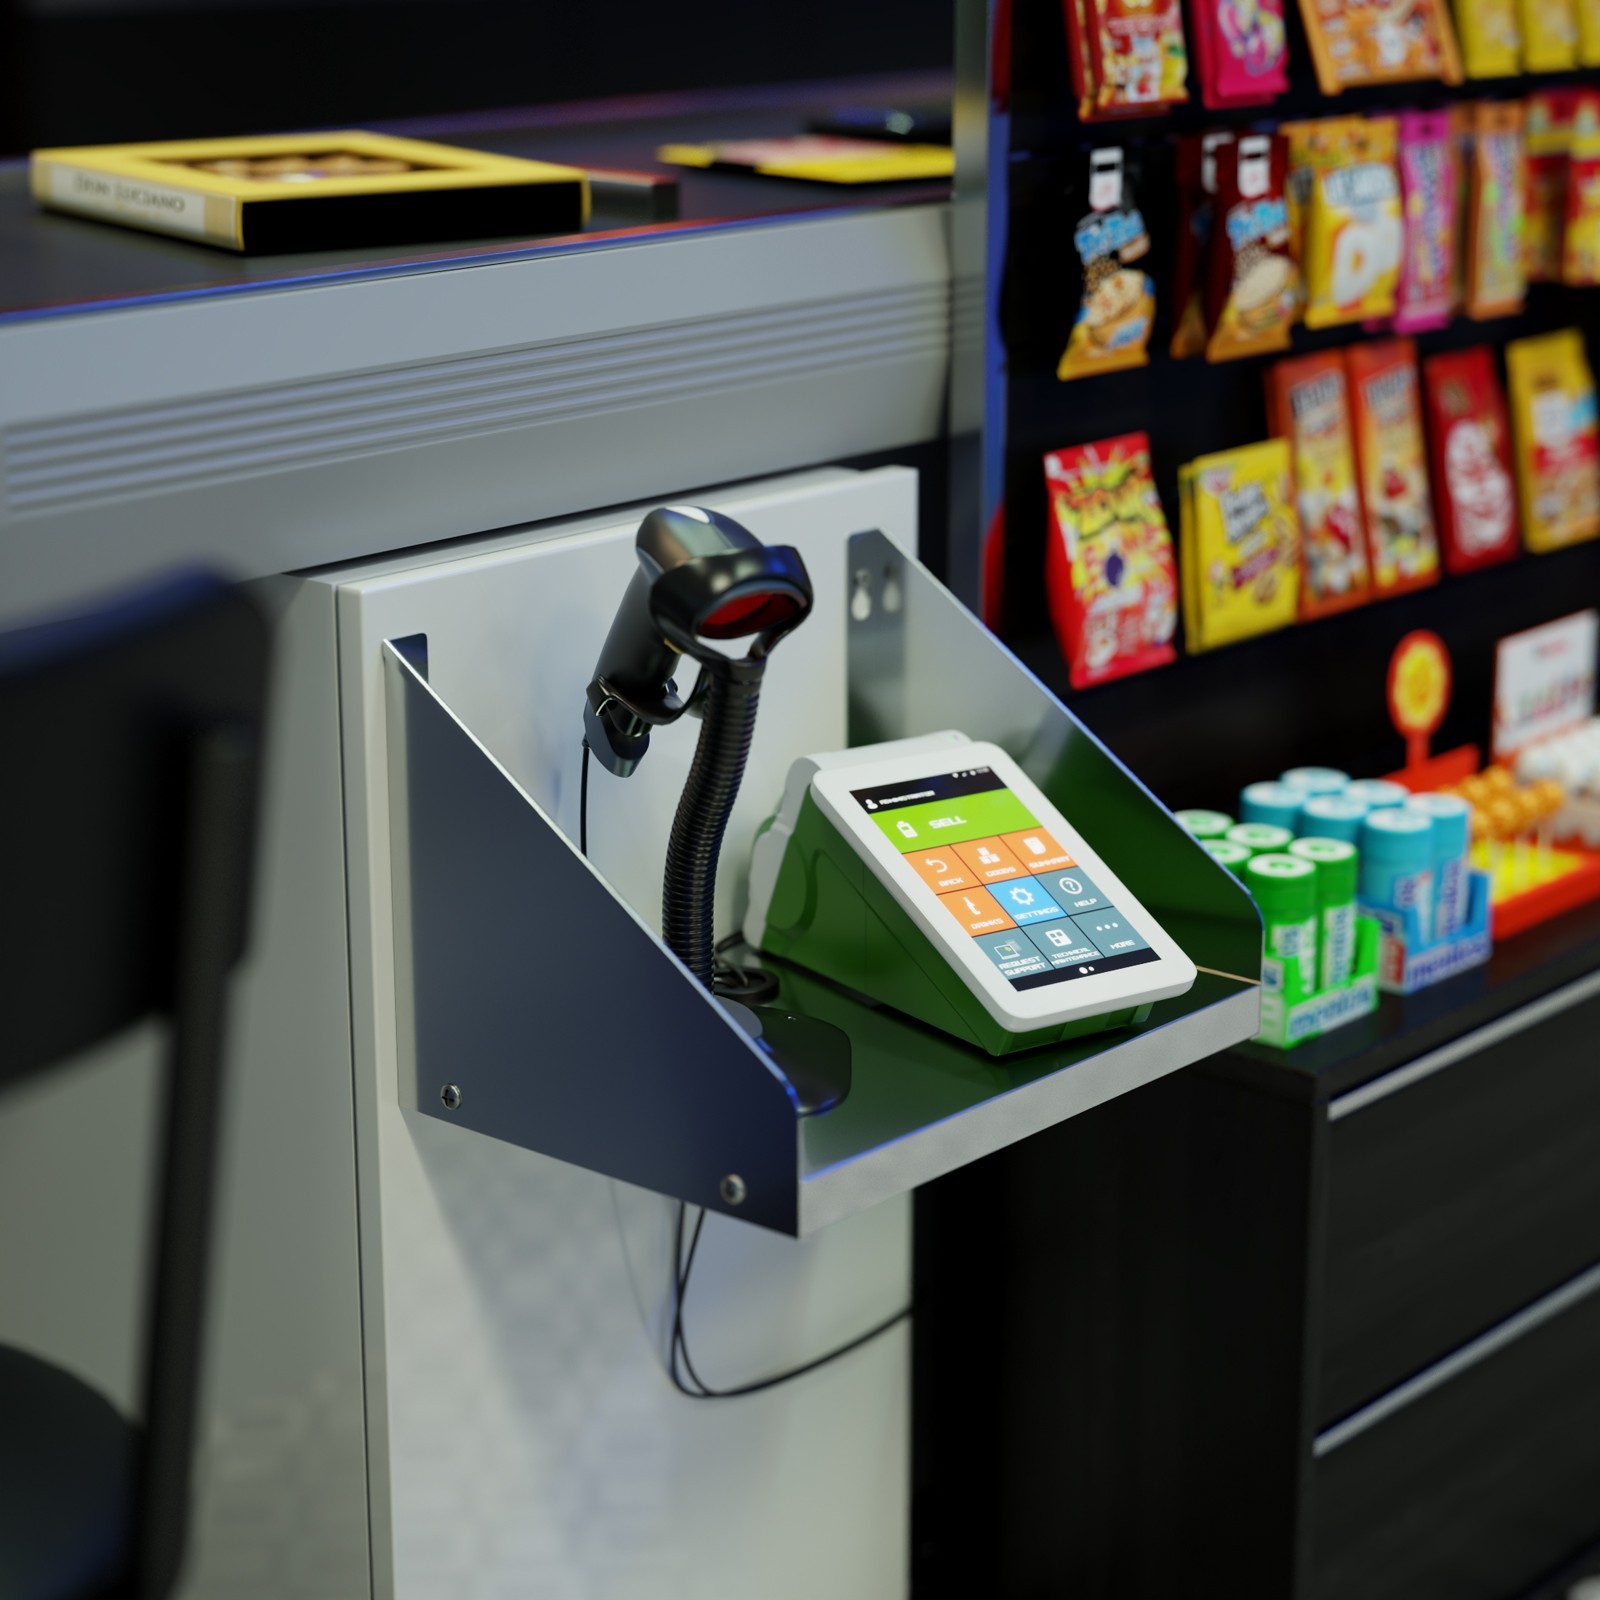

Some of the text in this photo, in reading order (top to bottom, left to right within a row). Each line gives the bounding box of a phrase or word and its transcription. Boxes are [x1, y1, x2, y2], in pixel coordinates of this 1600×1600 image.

[928, 816, 967, 829] SELL
[985, 866, 1017, 877] GOODS
[938, 877, 964, 887] BACK
[1074, 898, 1097, 908] HELP
[1014, 906, 1059, 920] SETTINGS
[970, 918, 1004, 930] DRINKS
[1109, 939, 1136, 950] MORE
[998, 955, 1041, 970] REQUEST
[1004, 962, 1046, 976] SUPPORT
